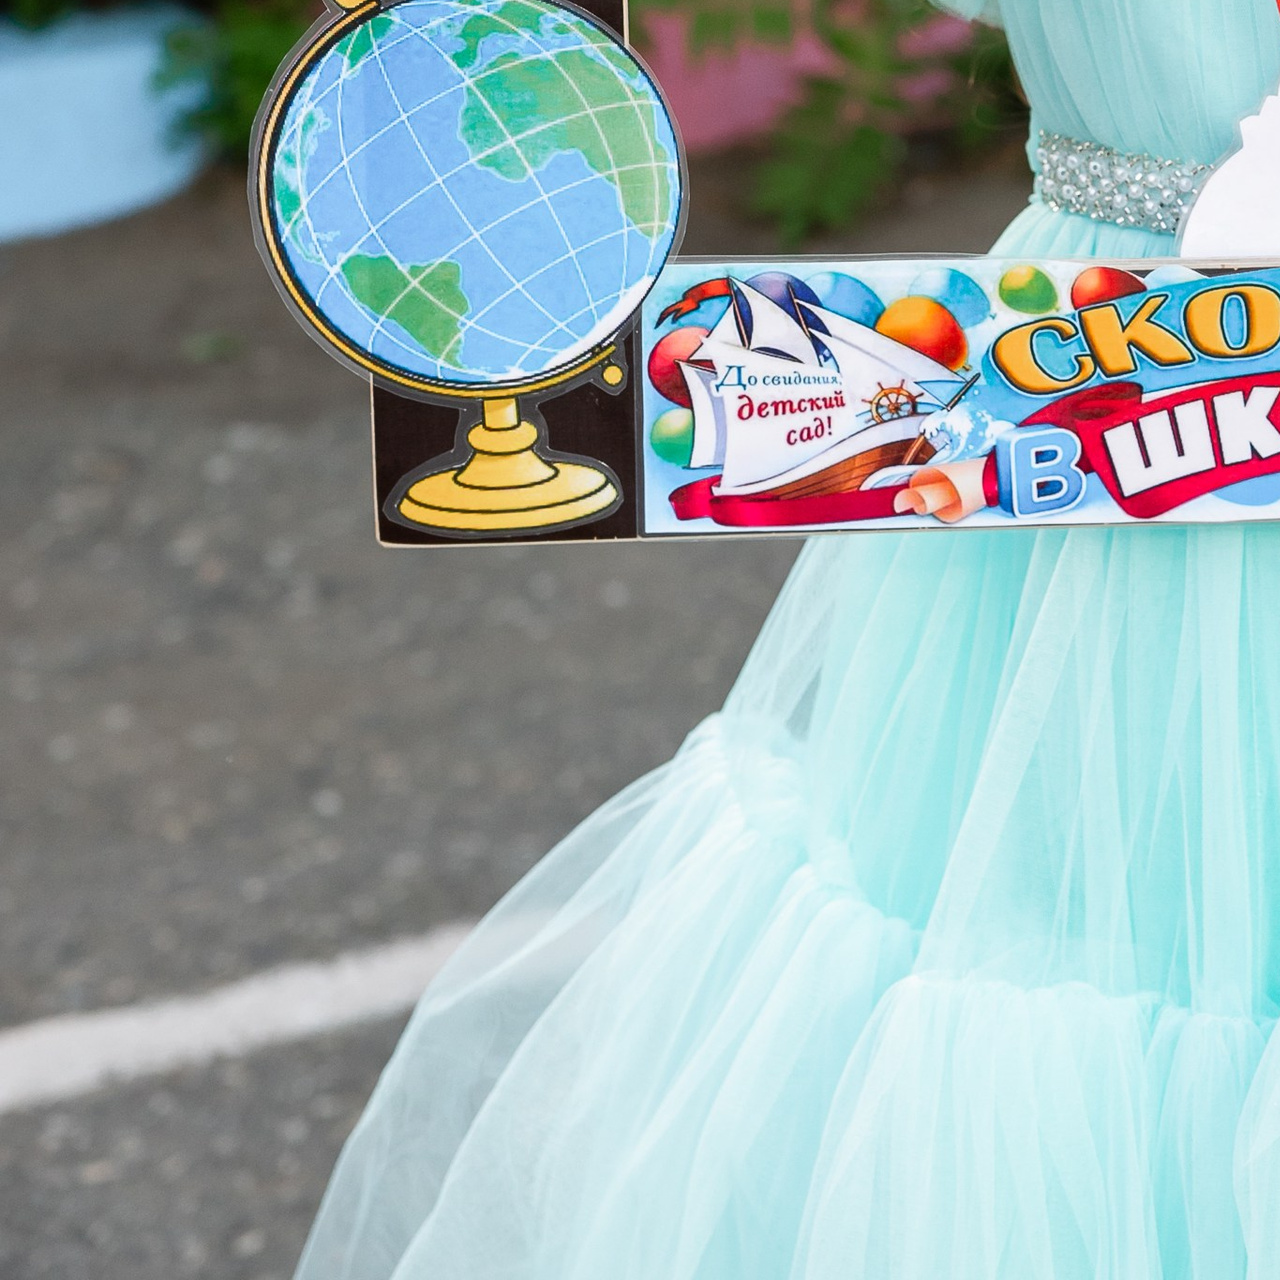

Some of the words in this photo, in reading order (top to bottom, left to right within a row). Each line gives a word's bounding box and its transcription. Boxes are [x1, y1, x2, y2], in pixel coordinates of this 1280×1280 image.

[714, 364, 758, 393] До
[762, 370, 843, 387] свидания,
[736, 390, 846, 421] детский
[786, 415, 833, 446] сад!
[995, 424, 1087, 520] В
